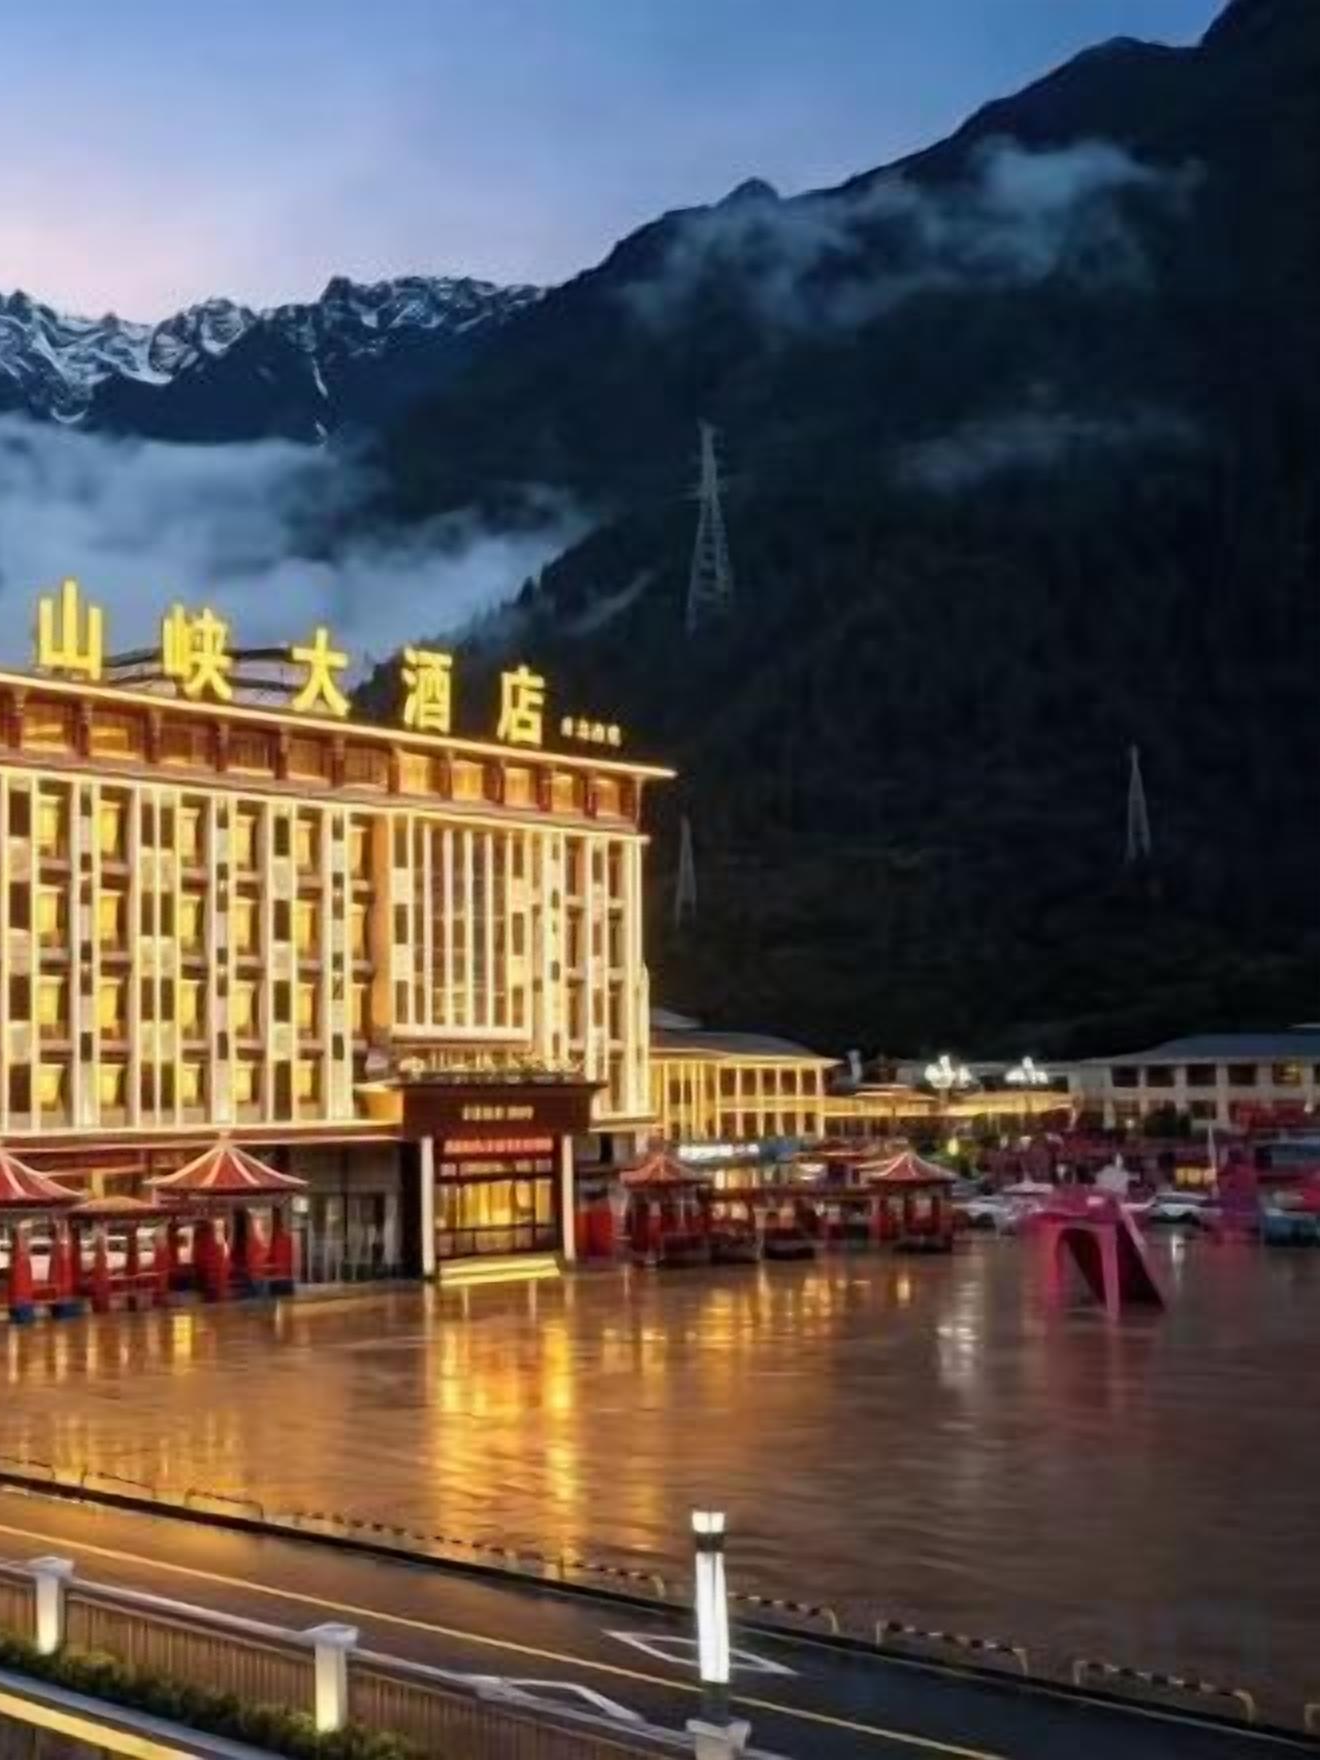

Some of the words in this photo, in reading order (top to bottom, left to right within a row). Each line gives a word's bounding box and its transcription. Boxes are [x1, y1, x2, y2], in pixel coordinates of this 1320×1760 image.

[39, 580, 545, 745] 山峡大酒店
